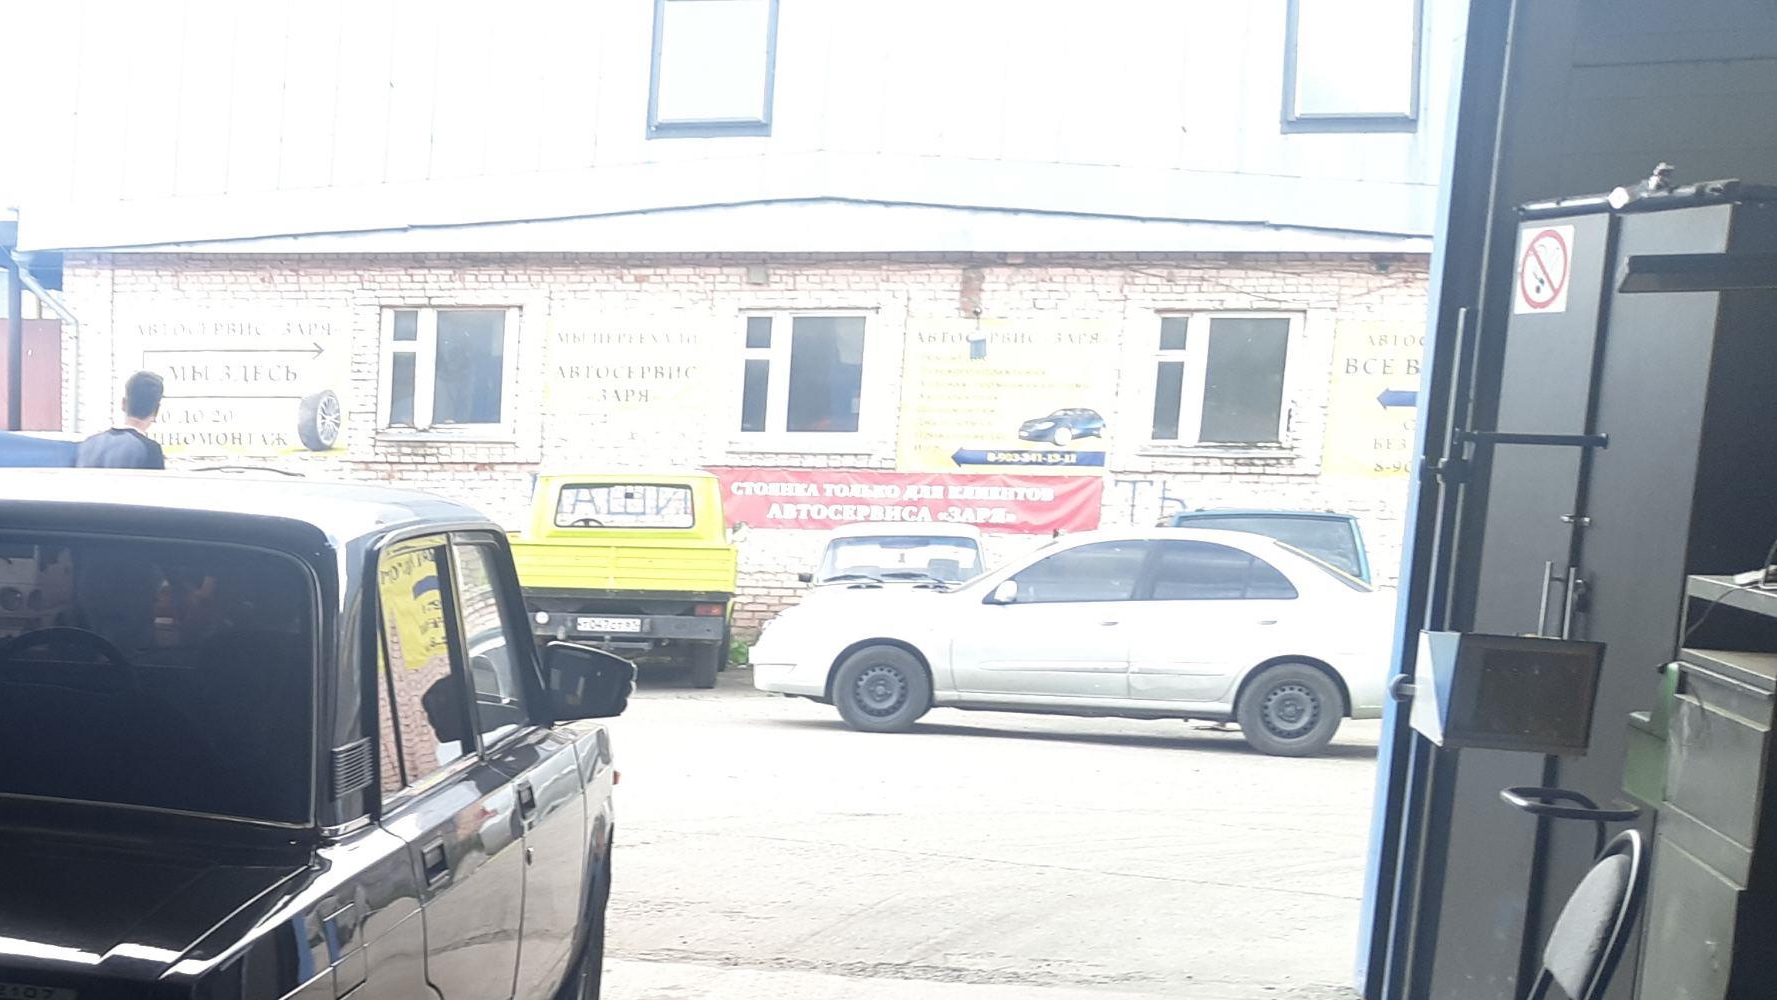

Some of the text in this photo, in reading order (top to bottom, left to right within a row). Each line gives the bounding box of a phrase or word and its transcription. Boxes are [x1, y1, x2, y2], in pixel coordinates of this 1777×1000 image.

[1344, 357, 1395, 376] ВСЕ
[730, 481, 1055, 501] СТОЯНКА ТОЛЬКО ДЛЯ КЛИЕНТОВ
[766, 502, 1017, 524] АВТОСЕРВИСА «ЗАРЯ»
